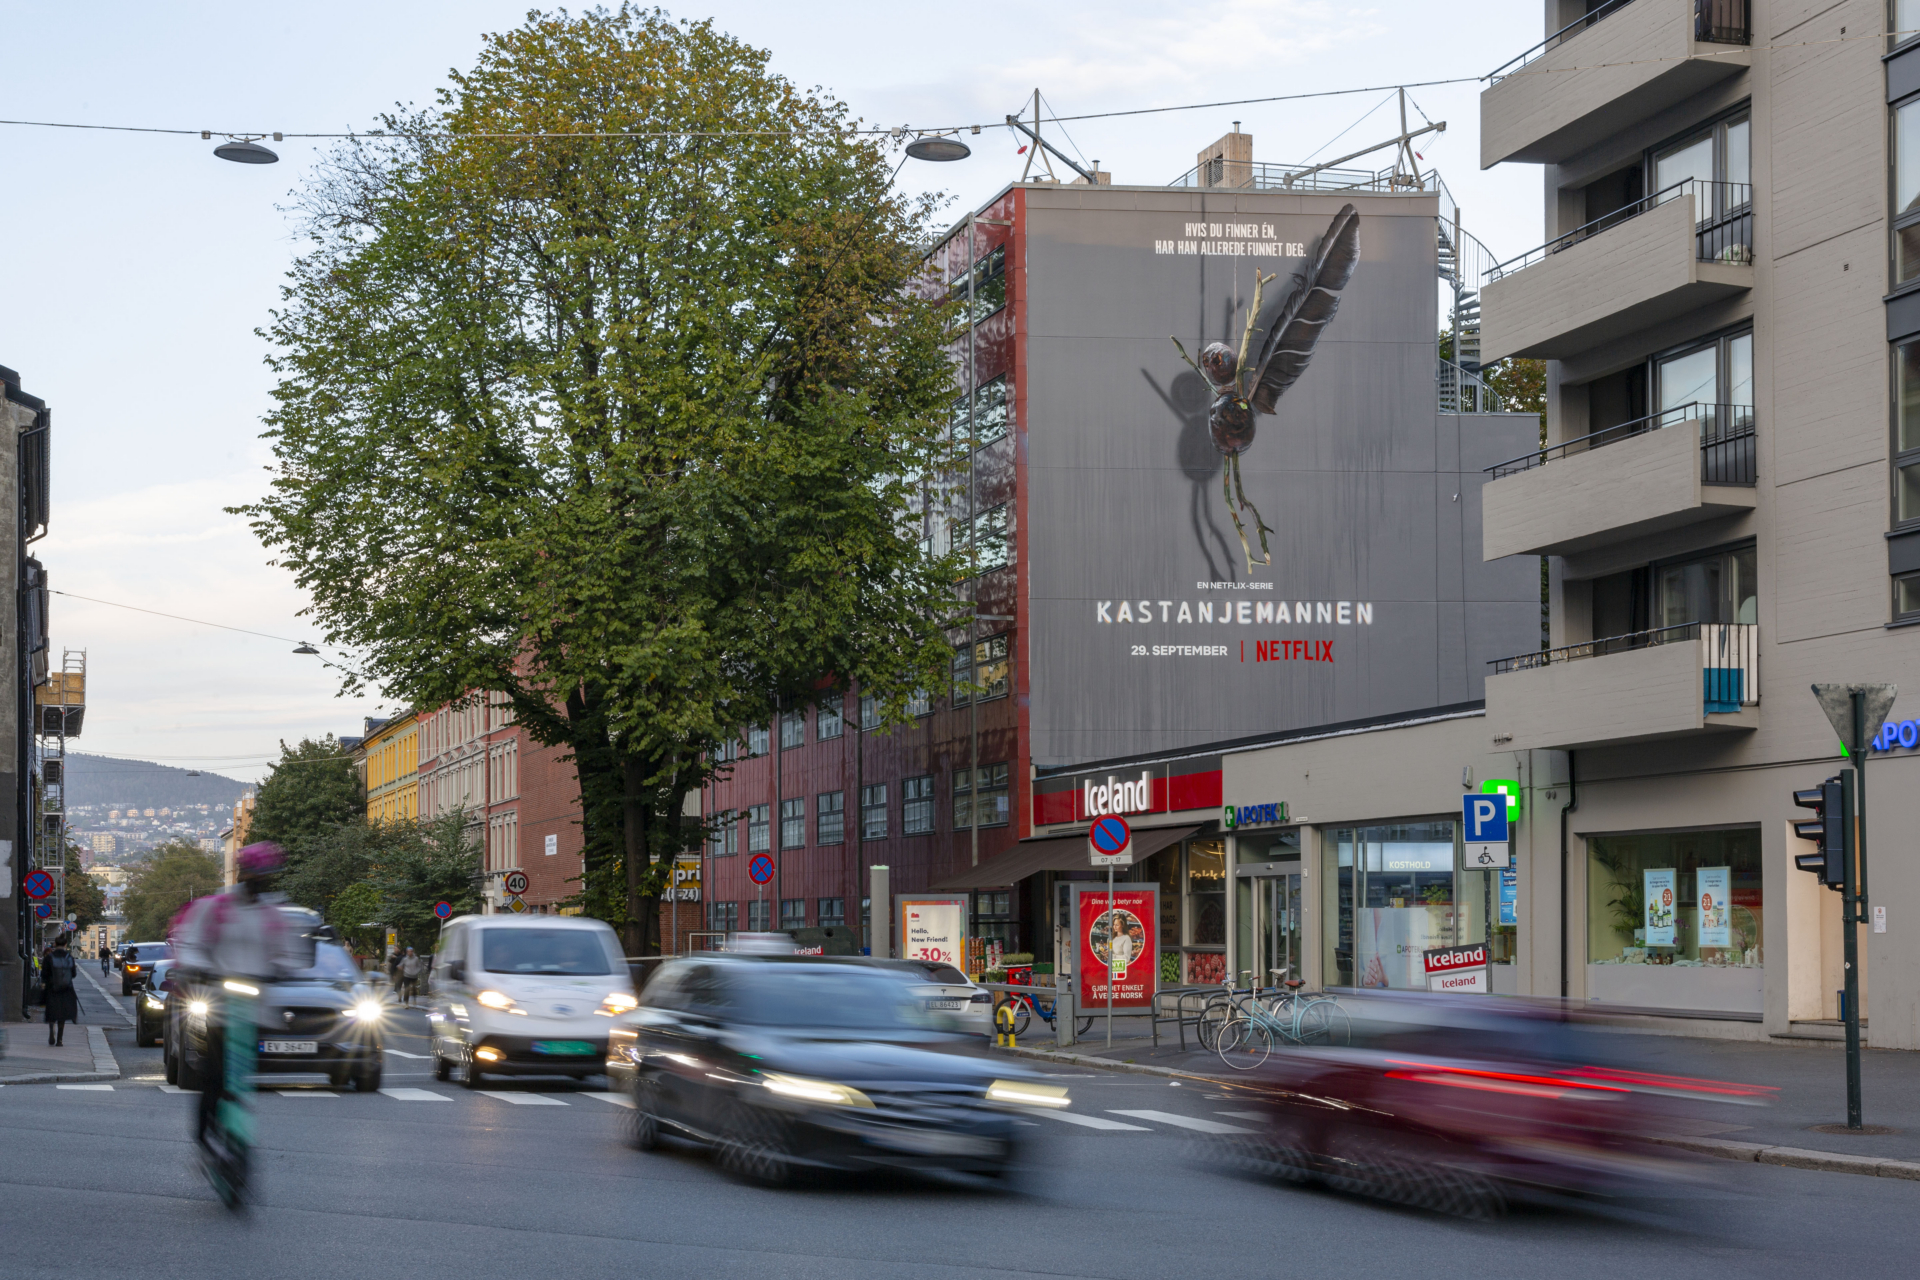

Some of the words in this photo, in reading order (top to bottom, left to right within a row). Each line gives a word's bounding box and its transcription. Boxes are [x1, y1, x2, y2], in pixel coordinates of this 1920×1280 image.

[1185, 222, 1206, 237] HVIS
[1210, 223, 1222, 238] DU
[1226, 224, 1258, 238] FINNER
[1262, 222, 1277, 240] ÉN,
[1155, 240, 1174, 254] HAR
[1178, 240, 1197, 255] HAN
[1201, 241, 1245, 256] ALLEREDE
[1248, 242, 1283, 256] FUNNET
[1286, 243, 1306, 257] DEG.
[1197, 582, 1209, 590] EN
[1210, 582, 1274, 590] NETFLIX-SERIE
[1097, 600, 1373, 624] KASTANJEMANNEN
[1131, 646, 1149, 656] 29.
[1152, 646, 1228, 656] SEPTEMBER
[1256, 640, 1334, 663] NETFLIX
[1872, 718, 1920, 750] PO
[1084, 771, 1149, 816] Iceland
[1474, 800, 1496, 836] P
[1389, 861, 1431, 869] KOSTHOLD
[510, 878, 526, 889] 40
[1428, 947, 1484, 968] Iceland
[1442, 976, 1476, 988] Iceland
